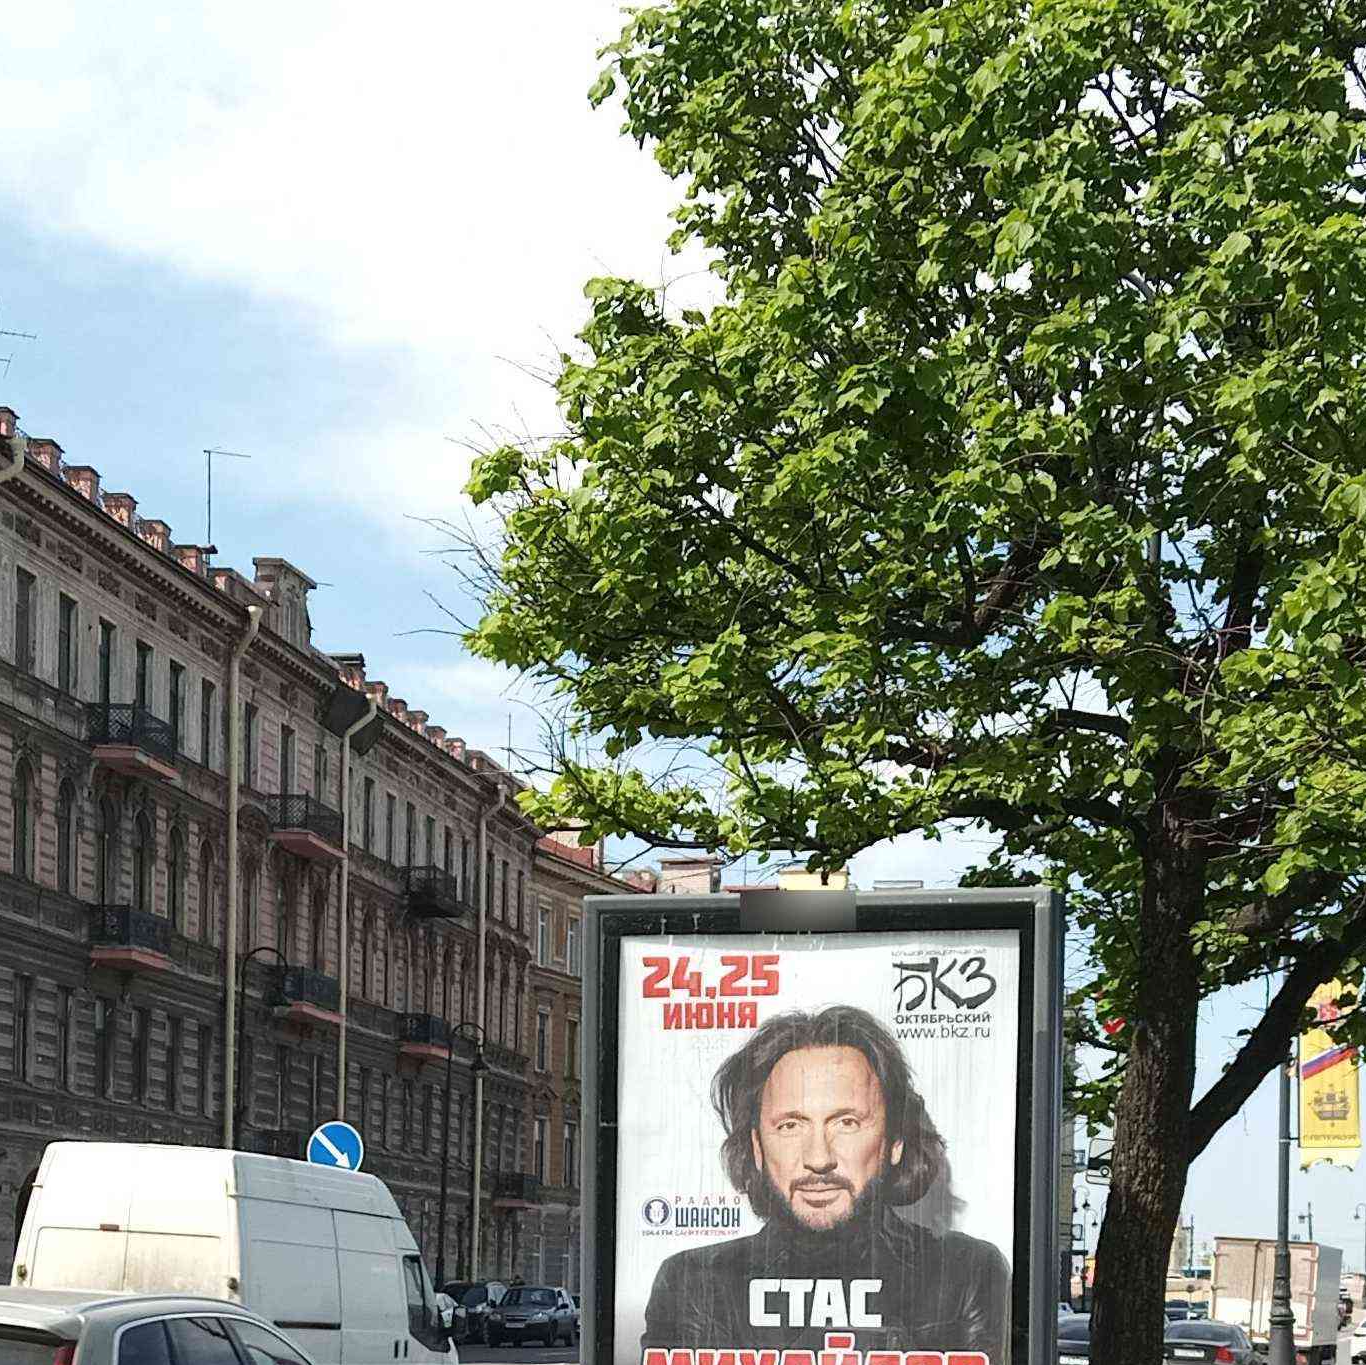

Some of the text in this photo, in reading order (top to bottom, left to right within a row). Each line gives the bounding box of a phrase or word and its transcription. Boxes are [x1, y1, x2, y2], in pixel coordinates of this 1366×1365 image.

[642, 954, 780, 999] 24,25
[892, 956, 997, 1013] БКЗ
[663, 1001, 758, 1031] ИЮНЯ
[895, 1011, 992, 1025] ОКТЯБРЬСКИЙ
[896, 1025, 991, 1040] www.bkz.ru
[675, 1195, 741, 1206] РАДИО
[675, 1207, 741, 1228] ШАНСОН
[749, 1278, 883, 1328] СТАС
